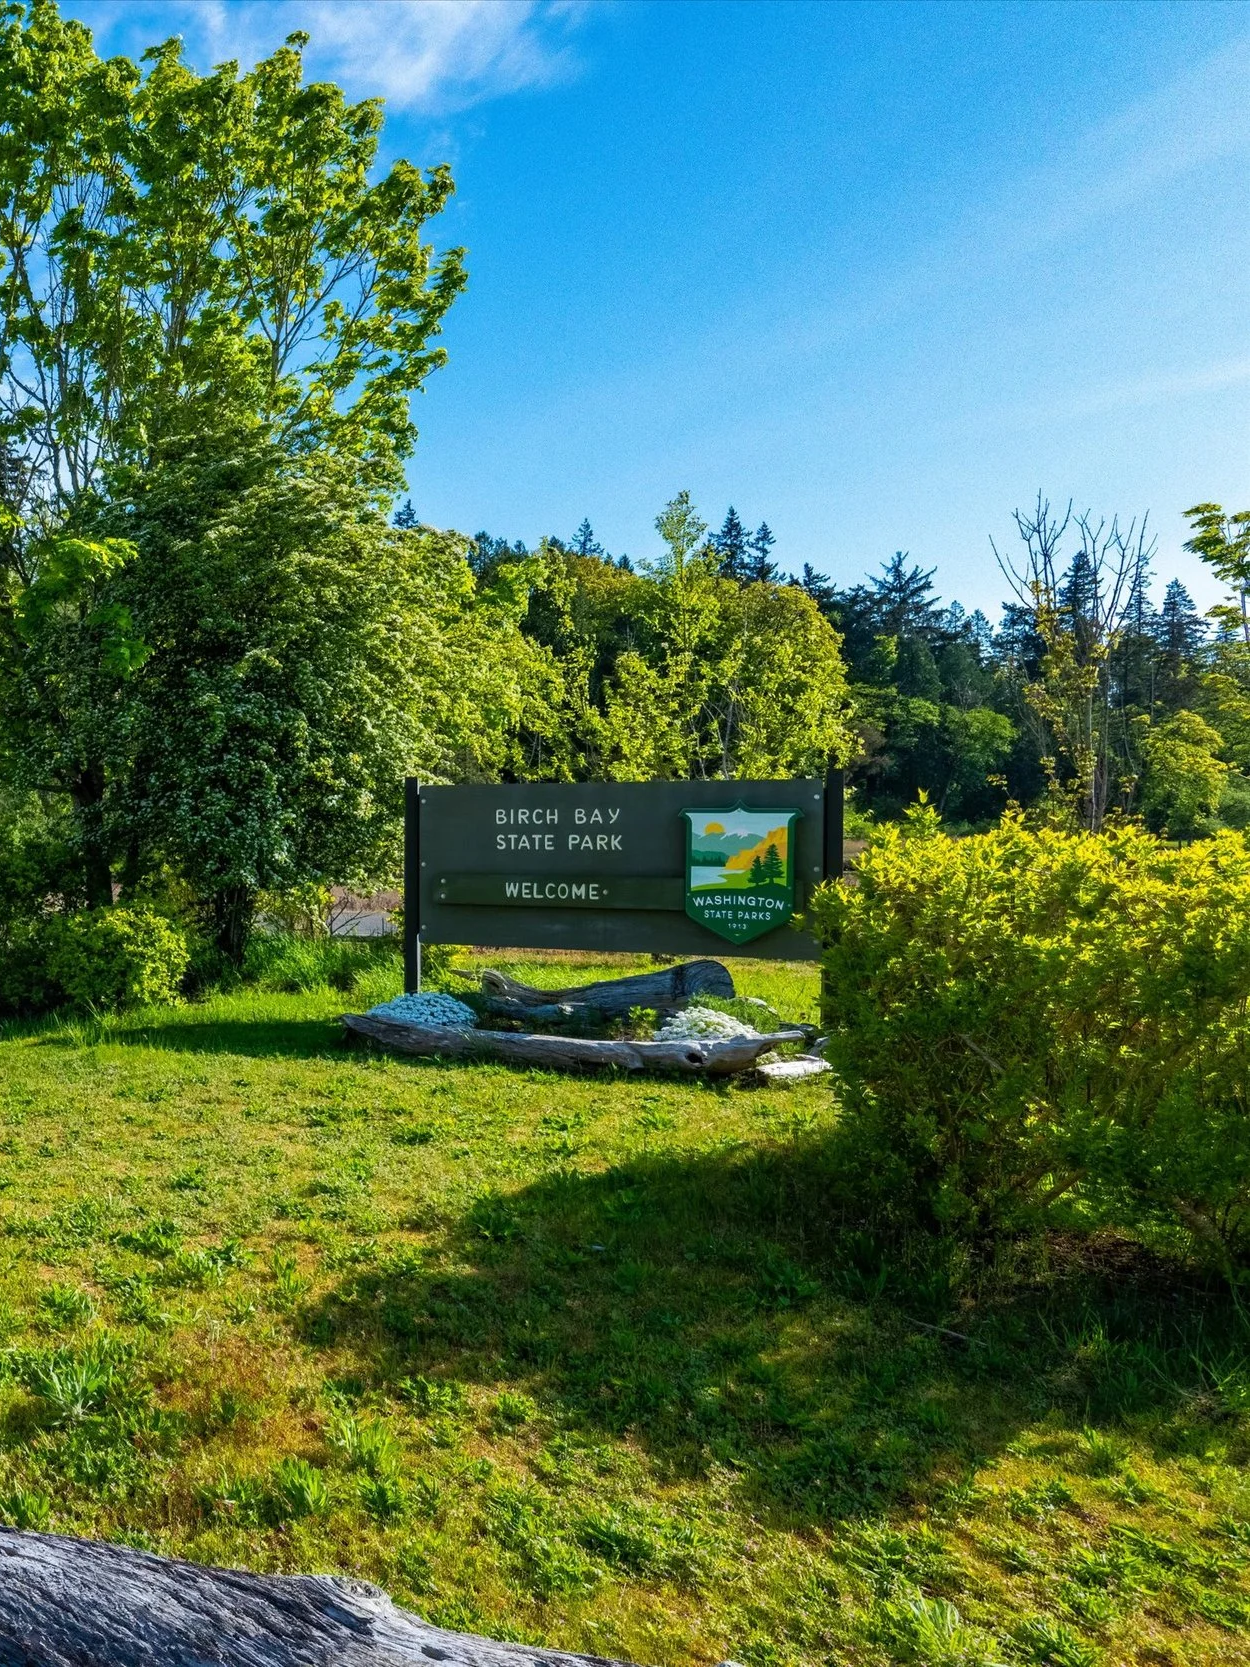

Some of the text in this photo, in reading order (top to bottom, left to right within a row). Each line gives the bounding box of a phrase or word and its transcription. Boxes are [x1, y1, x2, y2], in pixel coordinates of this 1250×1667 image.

[495, 808, 620, 825] BIRCH BAY
[496, 834, 623, 850] STATE PARK
[505, 882, 599, 900] WELCOME
[692, 895, 785, 911] WASHINGTON
[703, 910, 771, 921] STATE PARKS
